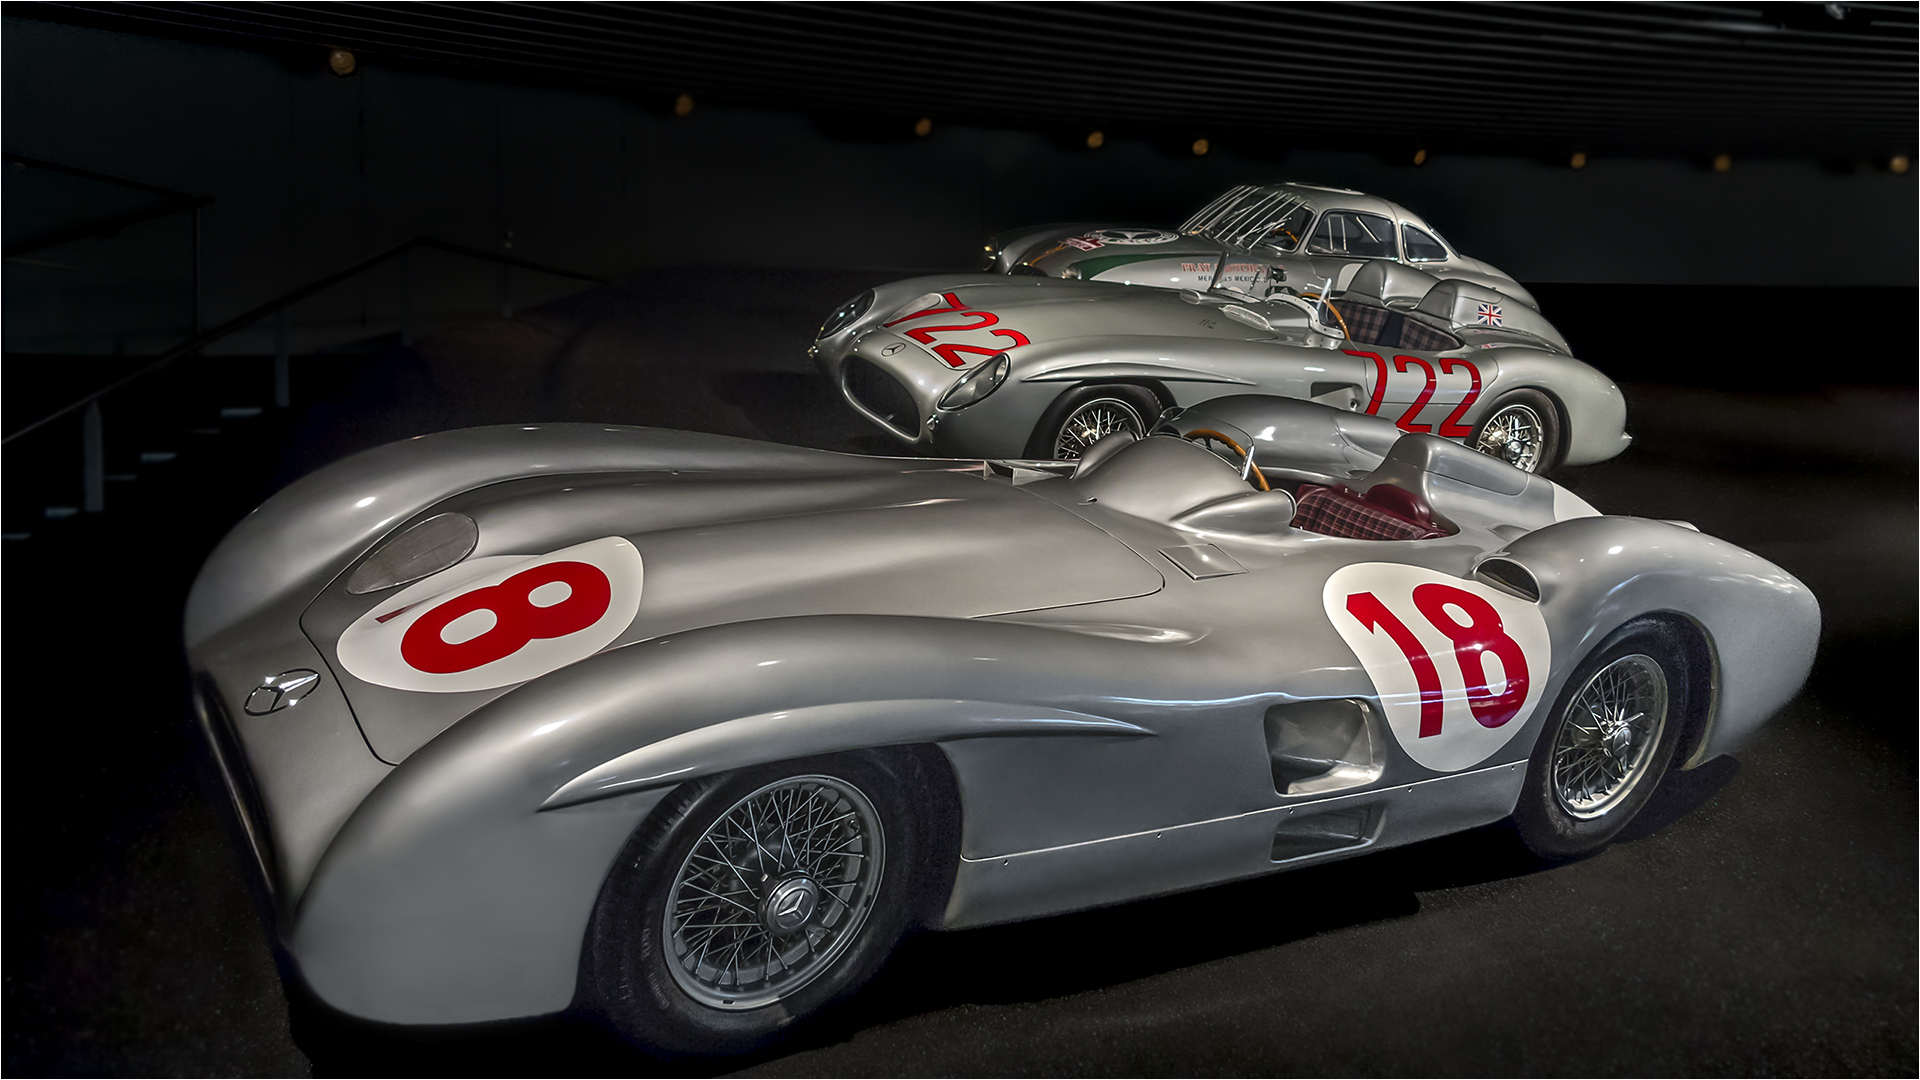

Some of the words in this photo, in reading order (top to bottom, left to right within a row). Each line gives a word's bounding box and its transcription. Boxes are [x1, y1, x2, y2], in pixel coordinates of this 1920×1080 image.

[883, 292, 1031, 368] 722
[1341, 349, 1482, 437] 722
[1346, 583, 1530, 739] 18
